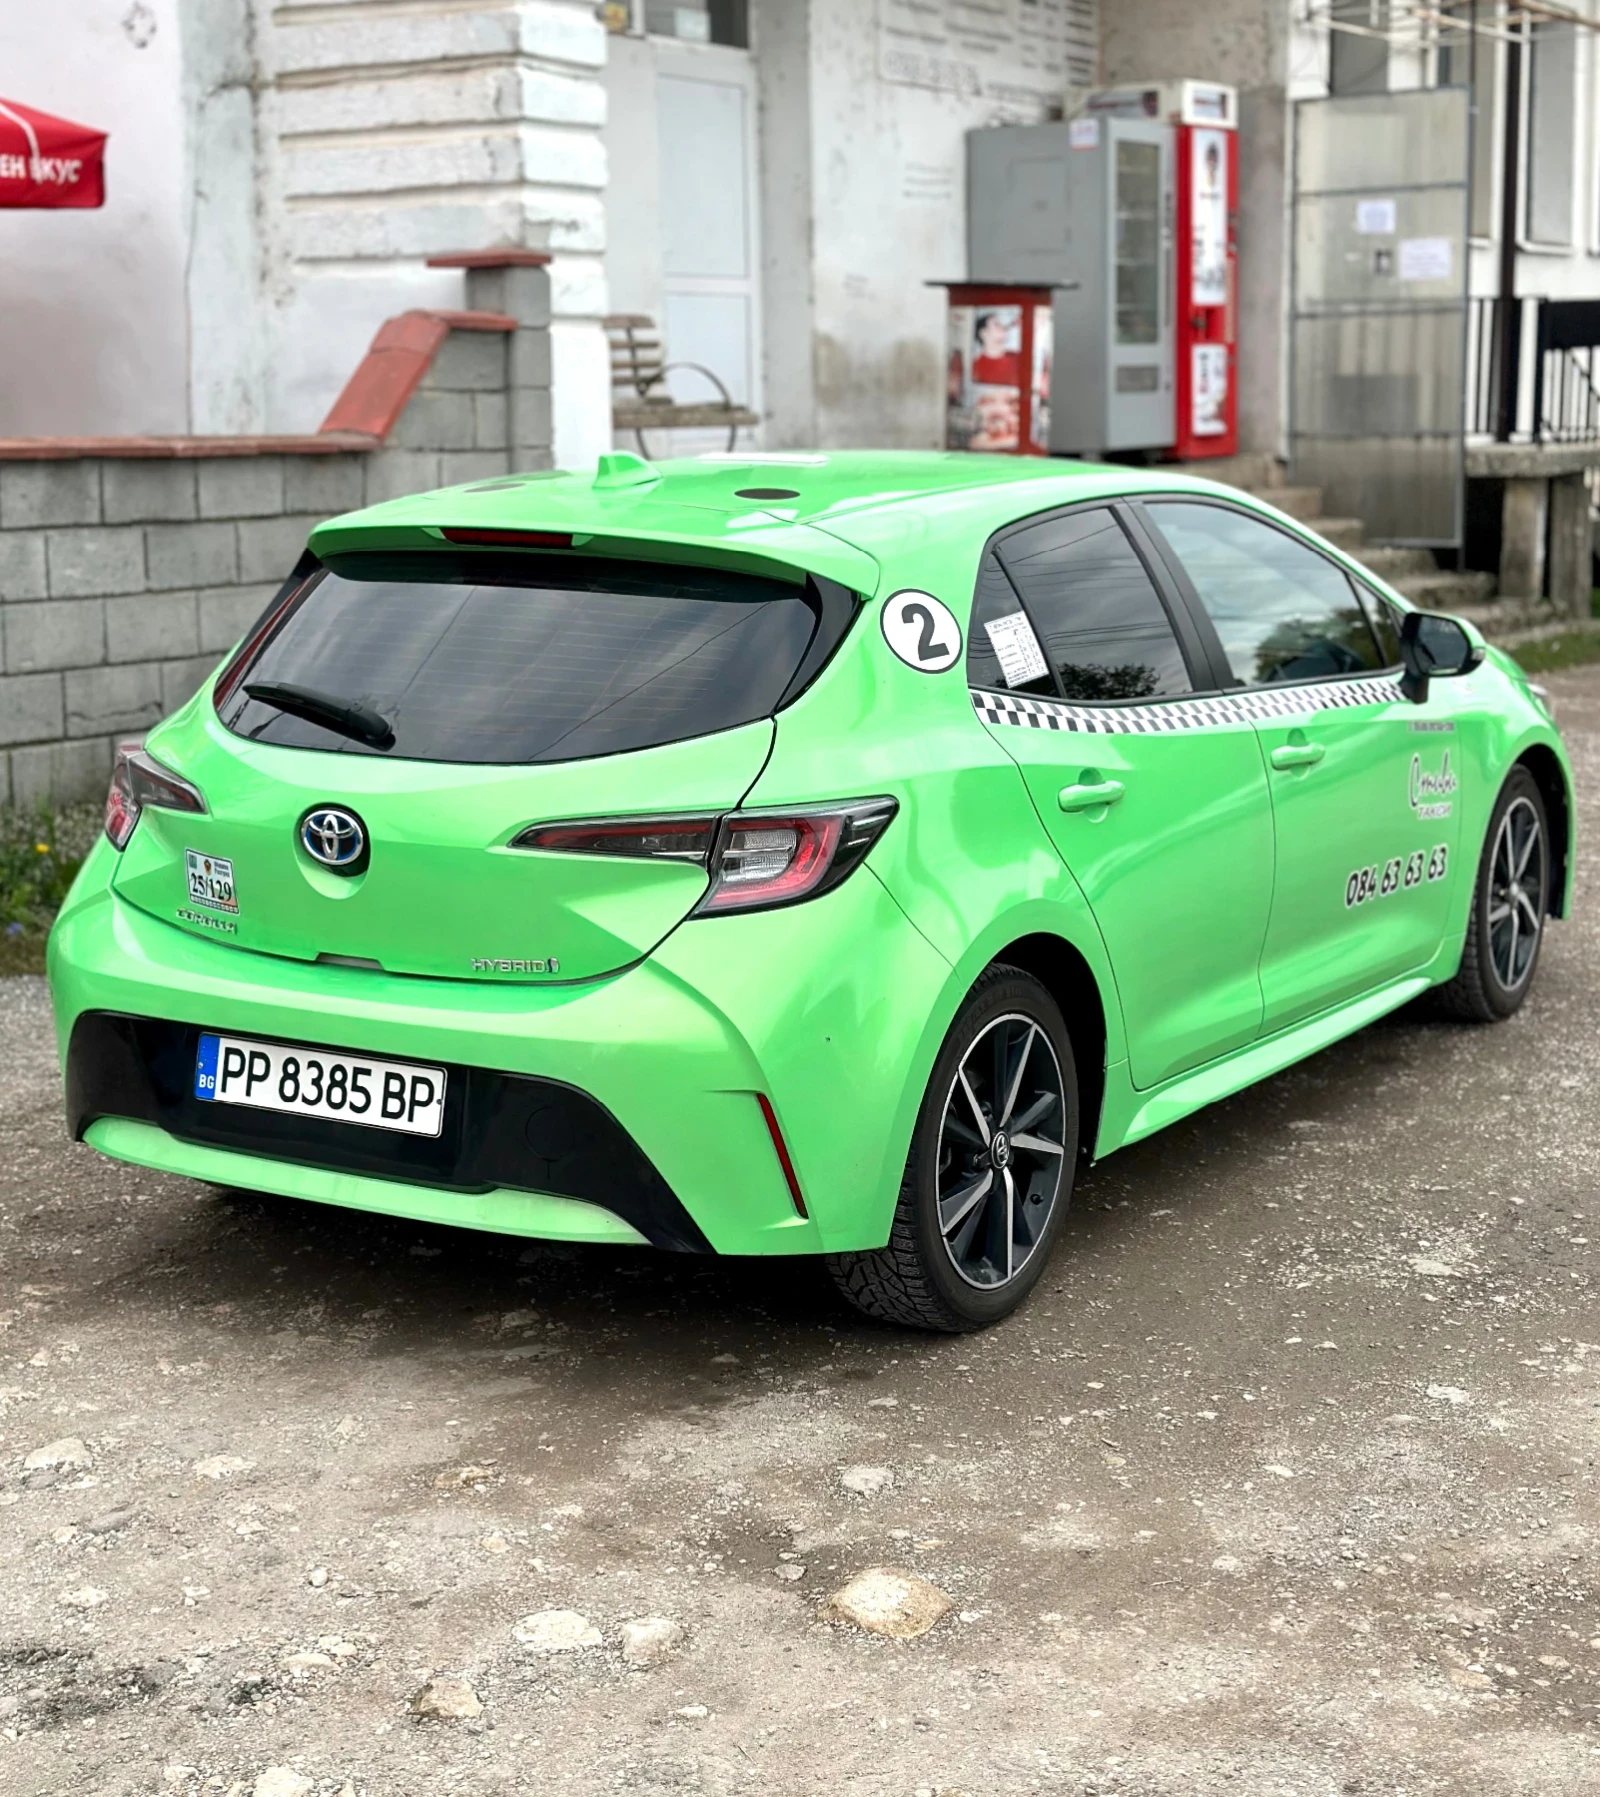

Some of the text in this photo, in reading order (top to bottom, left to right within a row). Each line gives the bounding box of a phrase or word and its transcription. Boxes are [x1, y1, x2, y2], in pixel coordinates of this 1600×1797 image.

[902, 603, 950, 662] 2
[190, 872, 232, 902] 25/129
[1346, 846, 1447, 907] 084 63 63 63
[471, 958, 545, 974] HYBRID
[199, 1073, 215, 1089] BG
[221, 1046, 434, 1122] PP 8385 BP
